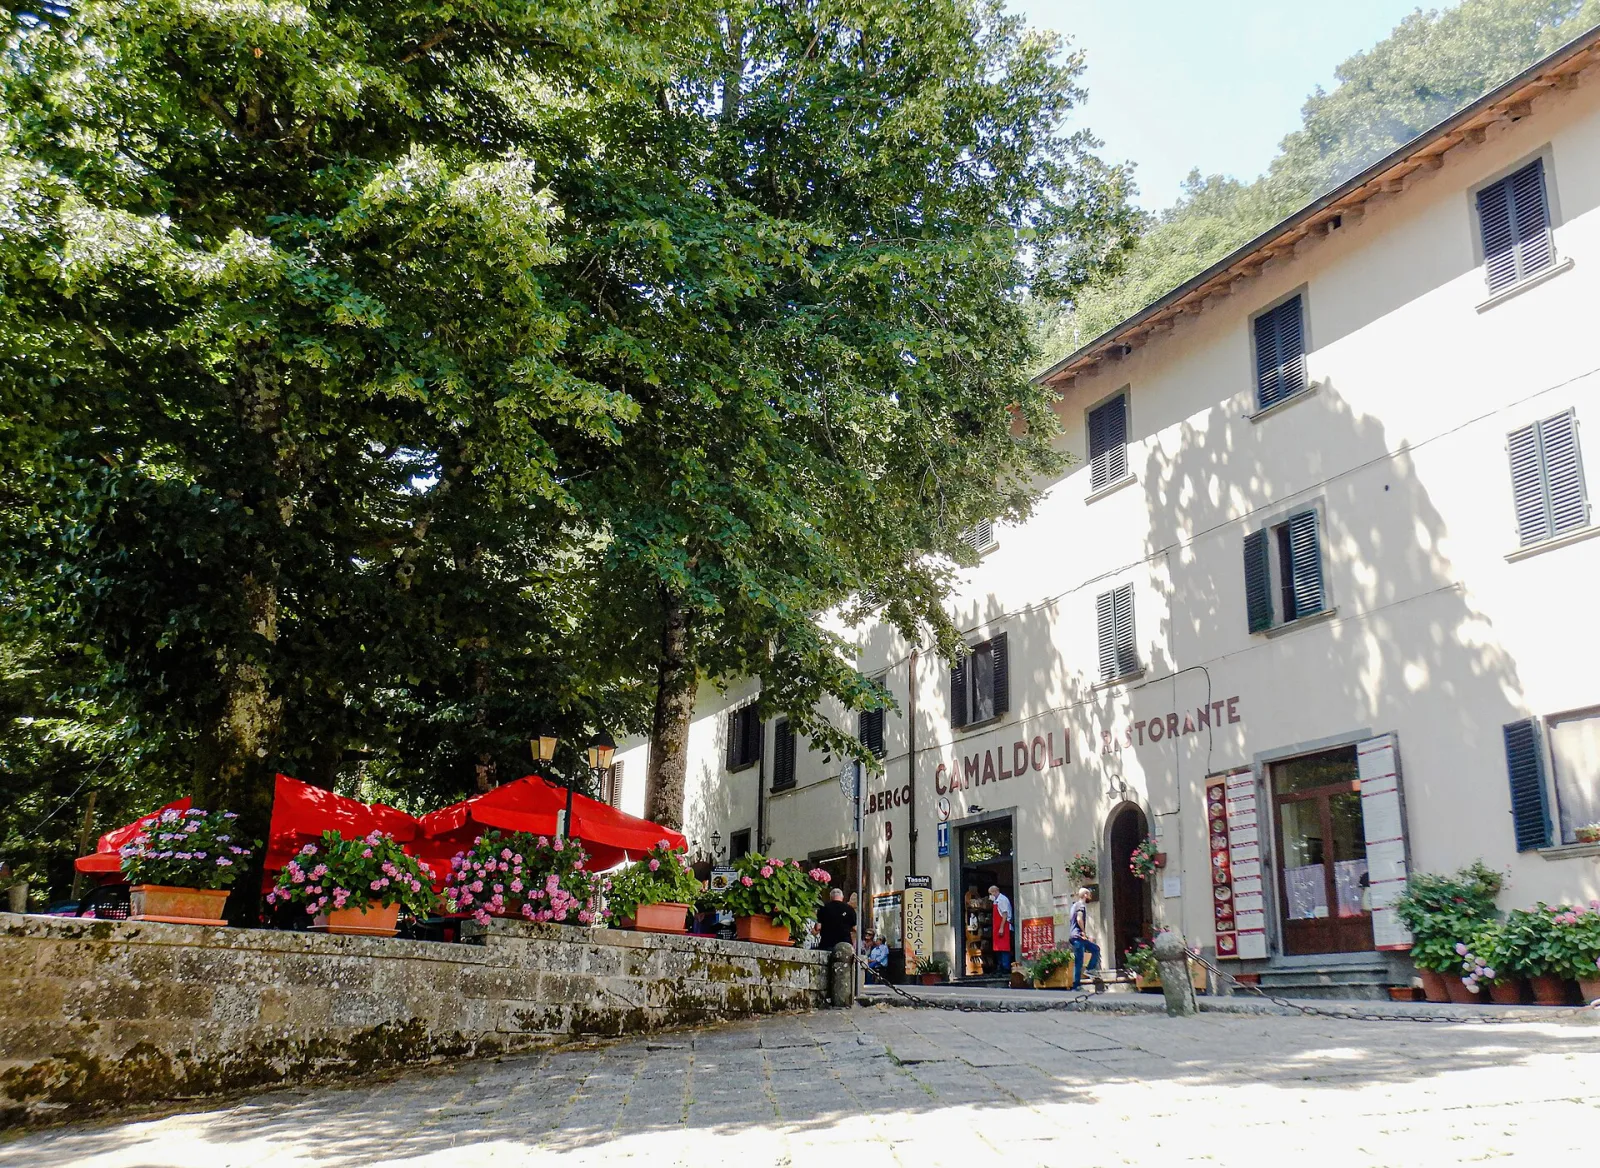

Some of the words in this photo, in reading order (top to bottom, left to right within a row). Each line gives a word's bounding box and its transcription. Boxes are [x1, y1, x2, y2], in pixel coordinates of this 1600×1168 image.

[1100, 695, 1241, 755] RISTORANTE
[935, 727, 1071, 796] CAMALDOLI
[885, 821, 893, 885] BAR
[913, 891, 924, 956] SCHIACCIATE
